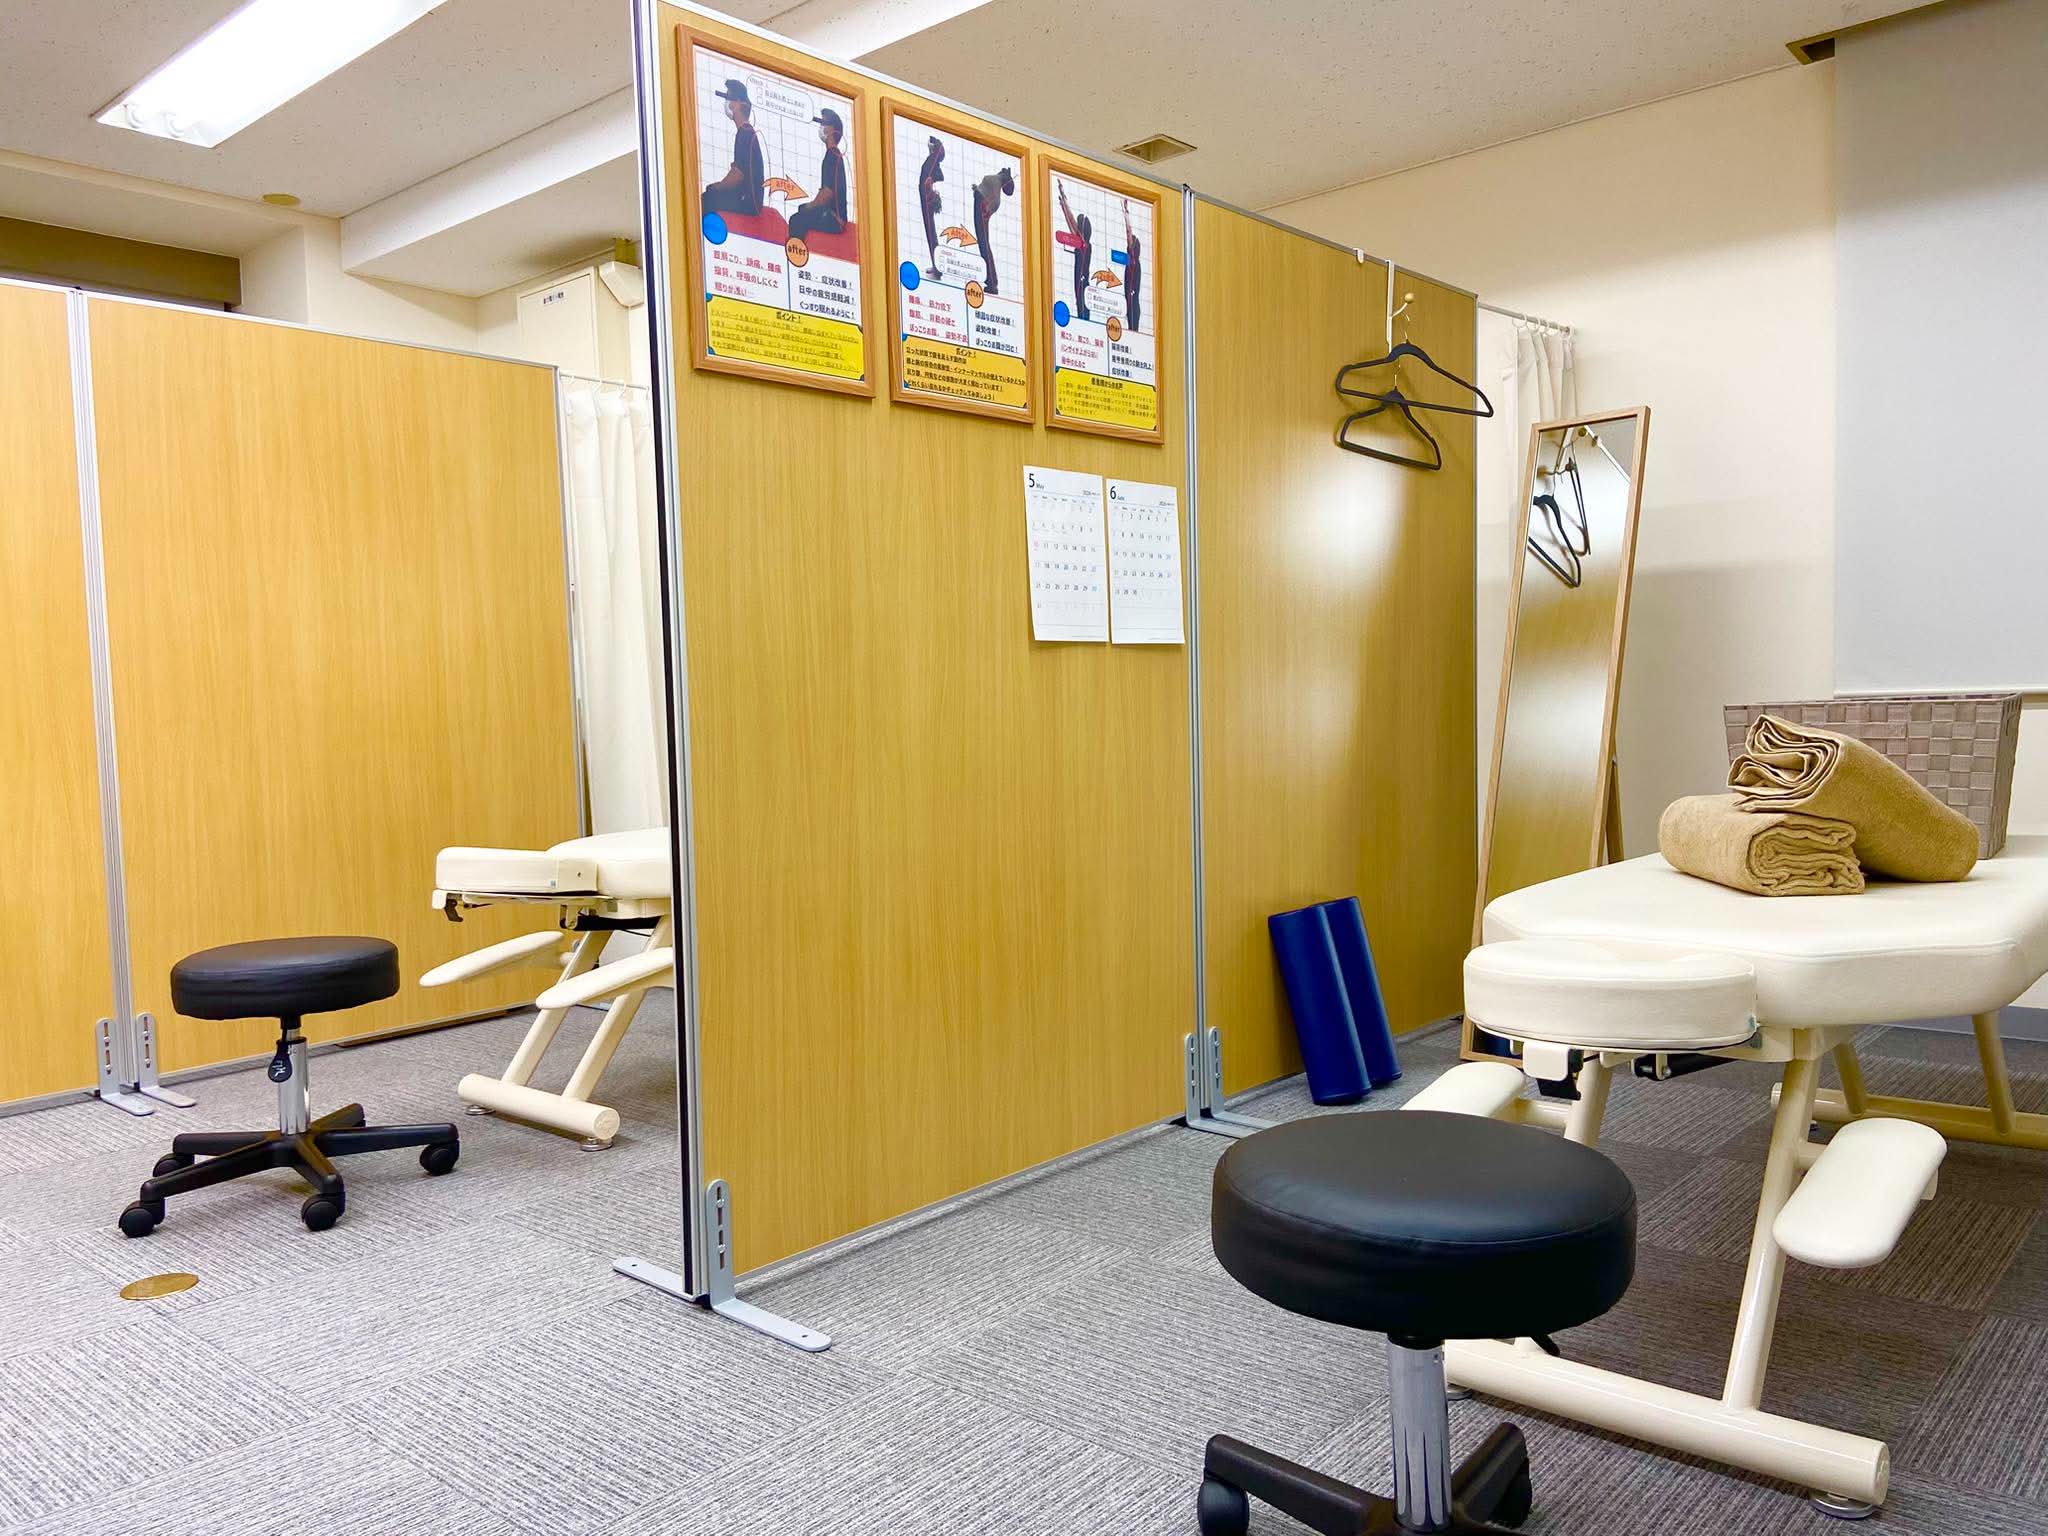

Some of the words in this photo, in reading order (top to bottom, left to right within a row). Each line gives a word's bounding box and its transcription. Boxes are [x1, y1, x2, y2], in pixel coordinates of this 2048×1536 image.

[787, 243, 807, 256] after
[1028, 473, 1035, 488] 5
[1109, 485, 1117, 500] 6
